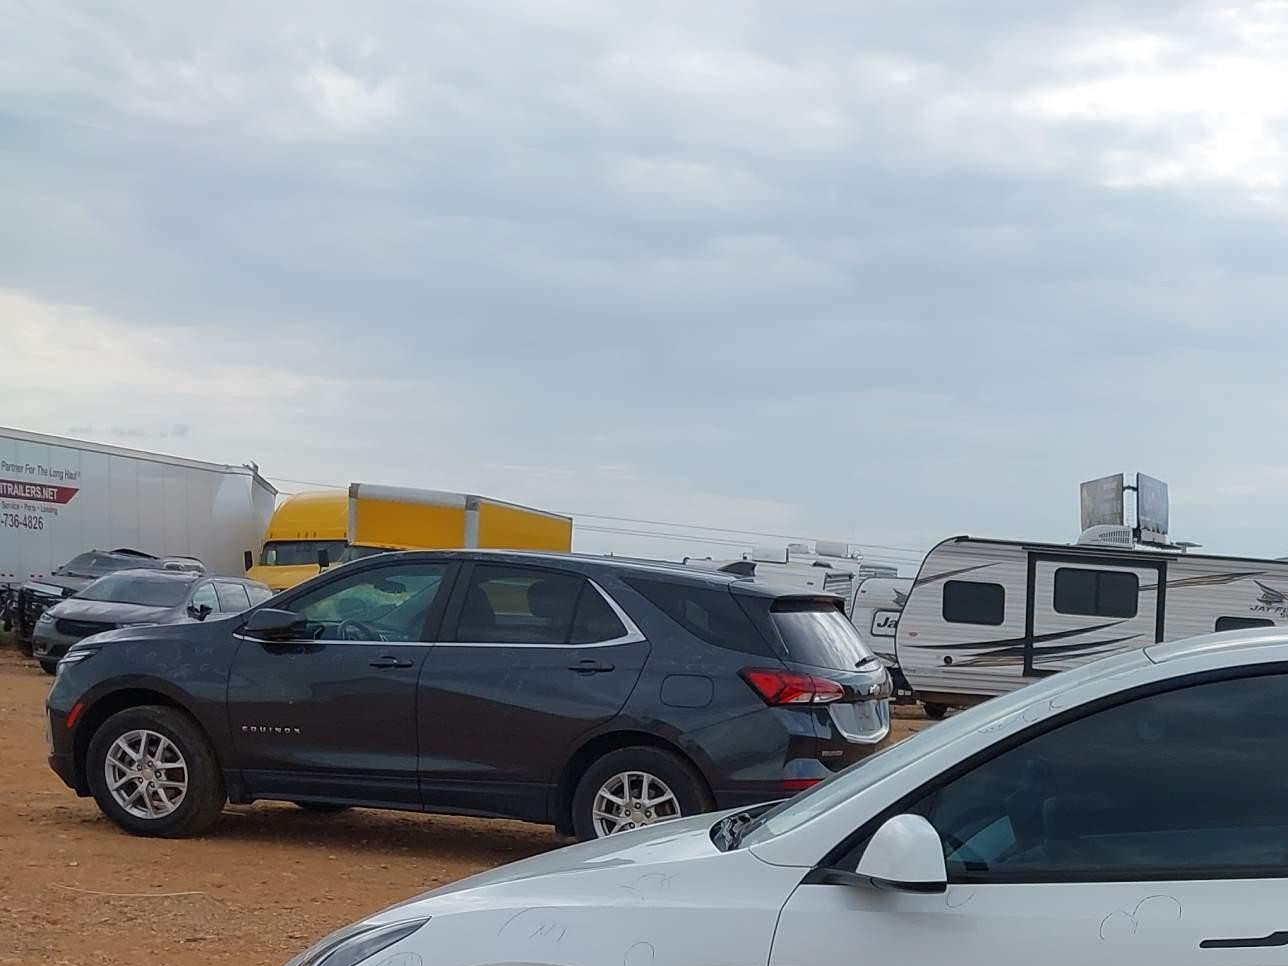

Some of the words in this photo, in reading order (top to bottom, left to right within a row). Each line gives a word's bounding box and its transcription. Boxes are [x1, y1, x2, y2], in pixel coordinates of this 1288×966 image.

[1, 461, 24, 473] Partner
[25, 463, 36, 475] For
[37, 465, 48, 477] The
[49, 467, 64, 481] Long
[241, 725, 301, 734] EQUINOX
